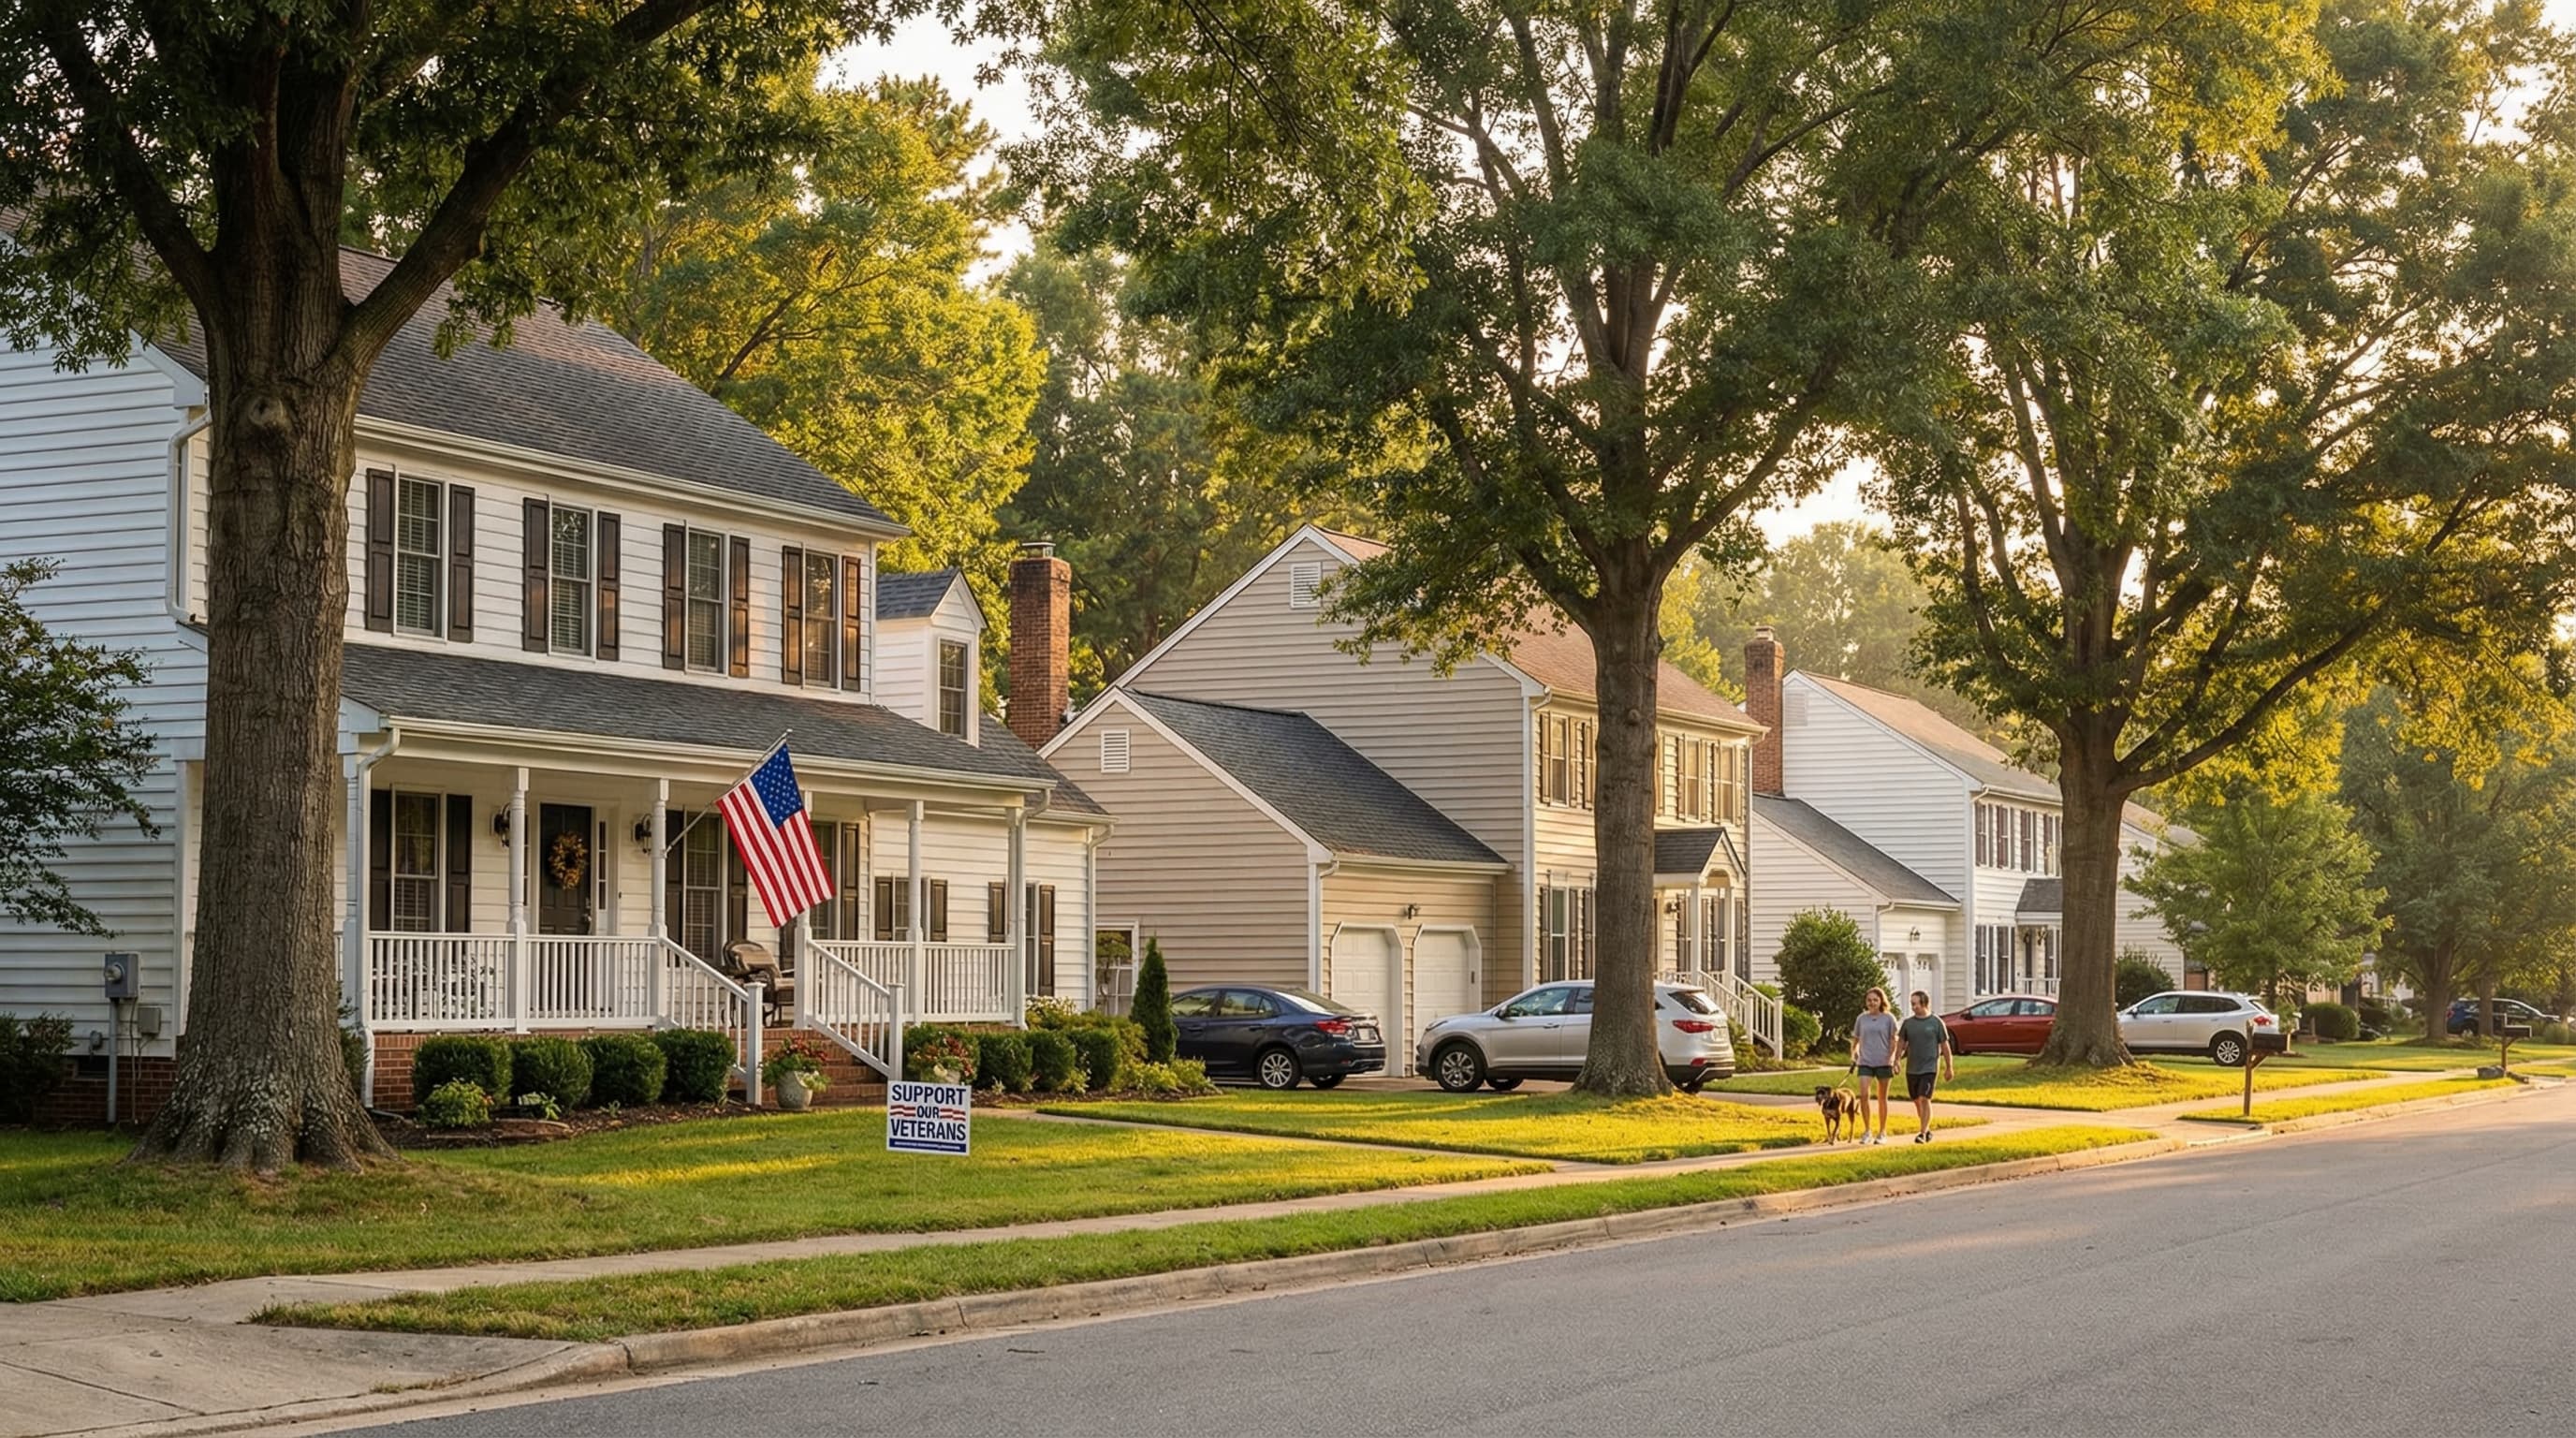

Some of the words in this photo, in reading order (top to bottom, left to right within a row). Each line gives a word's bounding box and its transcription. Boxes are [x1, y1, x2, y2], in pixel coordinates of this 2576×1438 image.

[892, 1084, 966, 1105] SUPPORT
[917, 1106, 940, 1119] OUR
[890, 1119, 966, 1141] VETERANS
